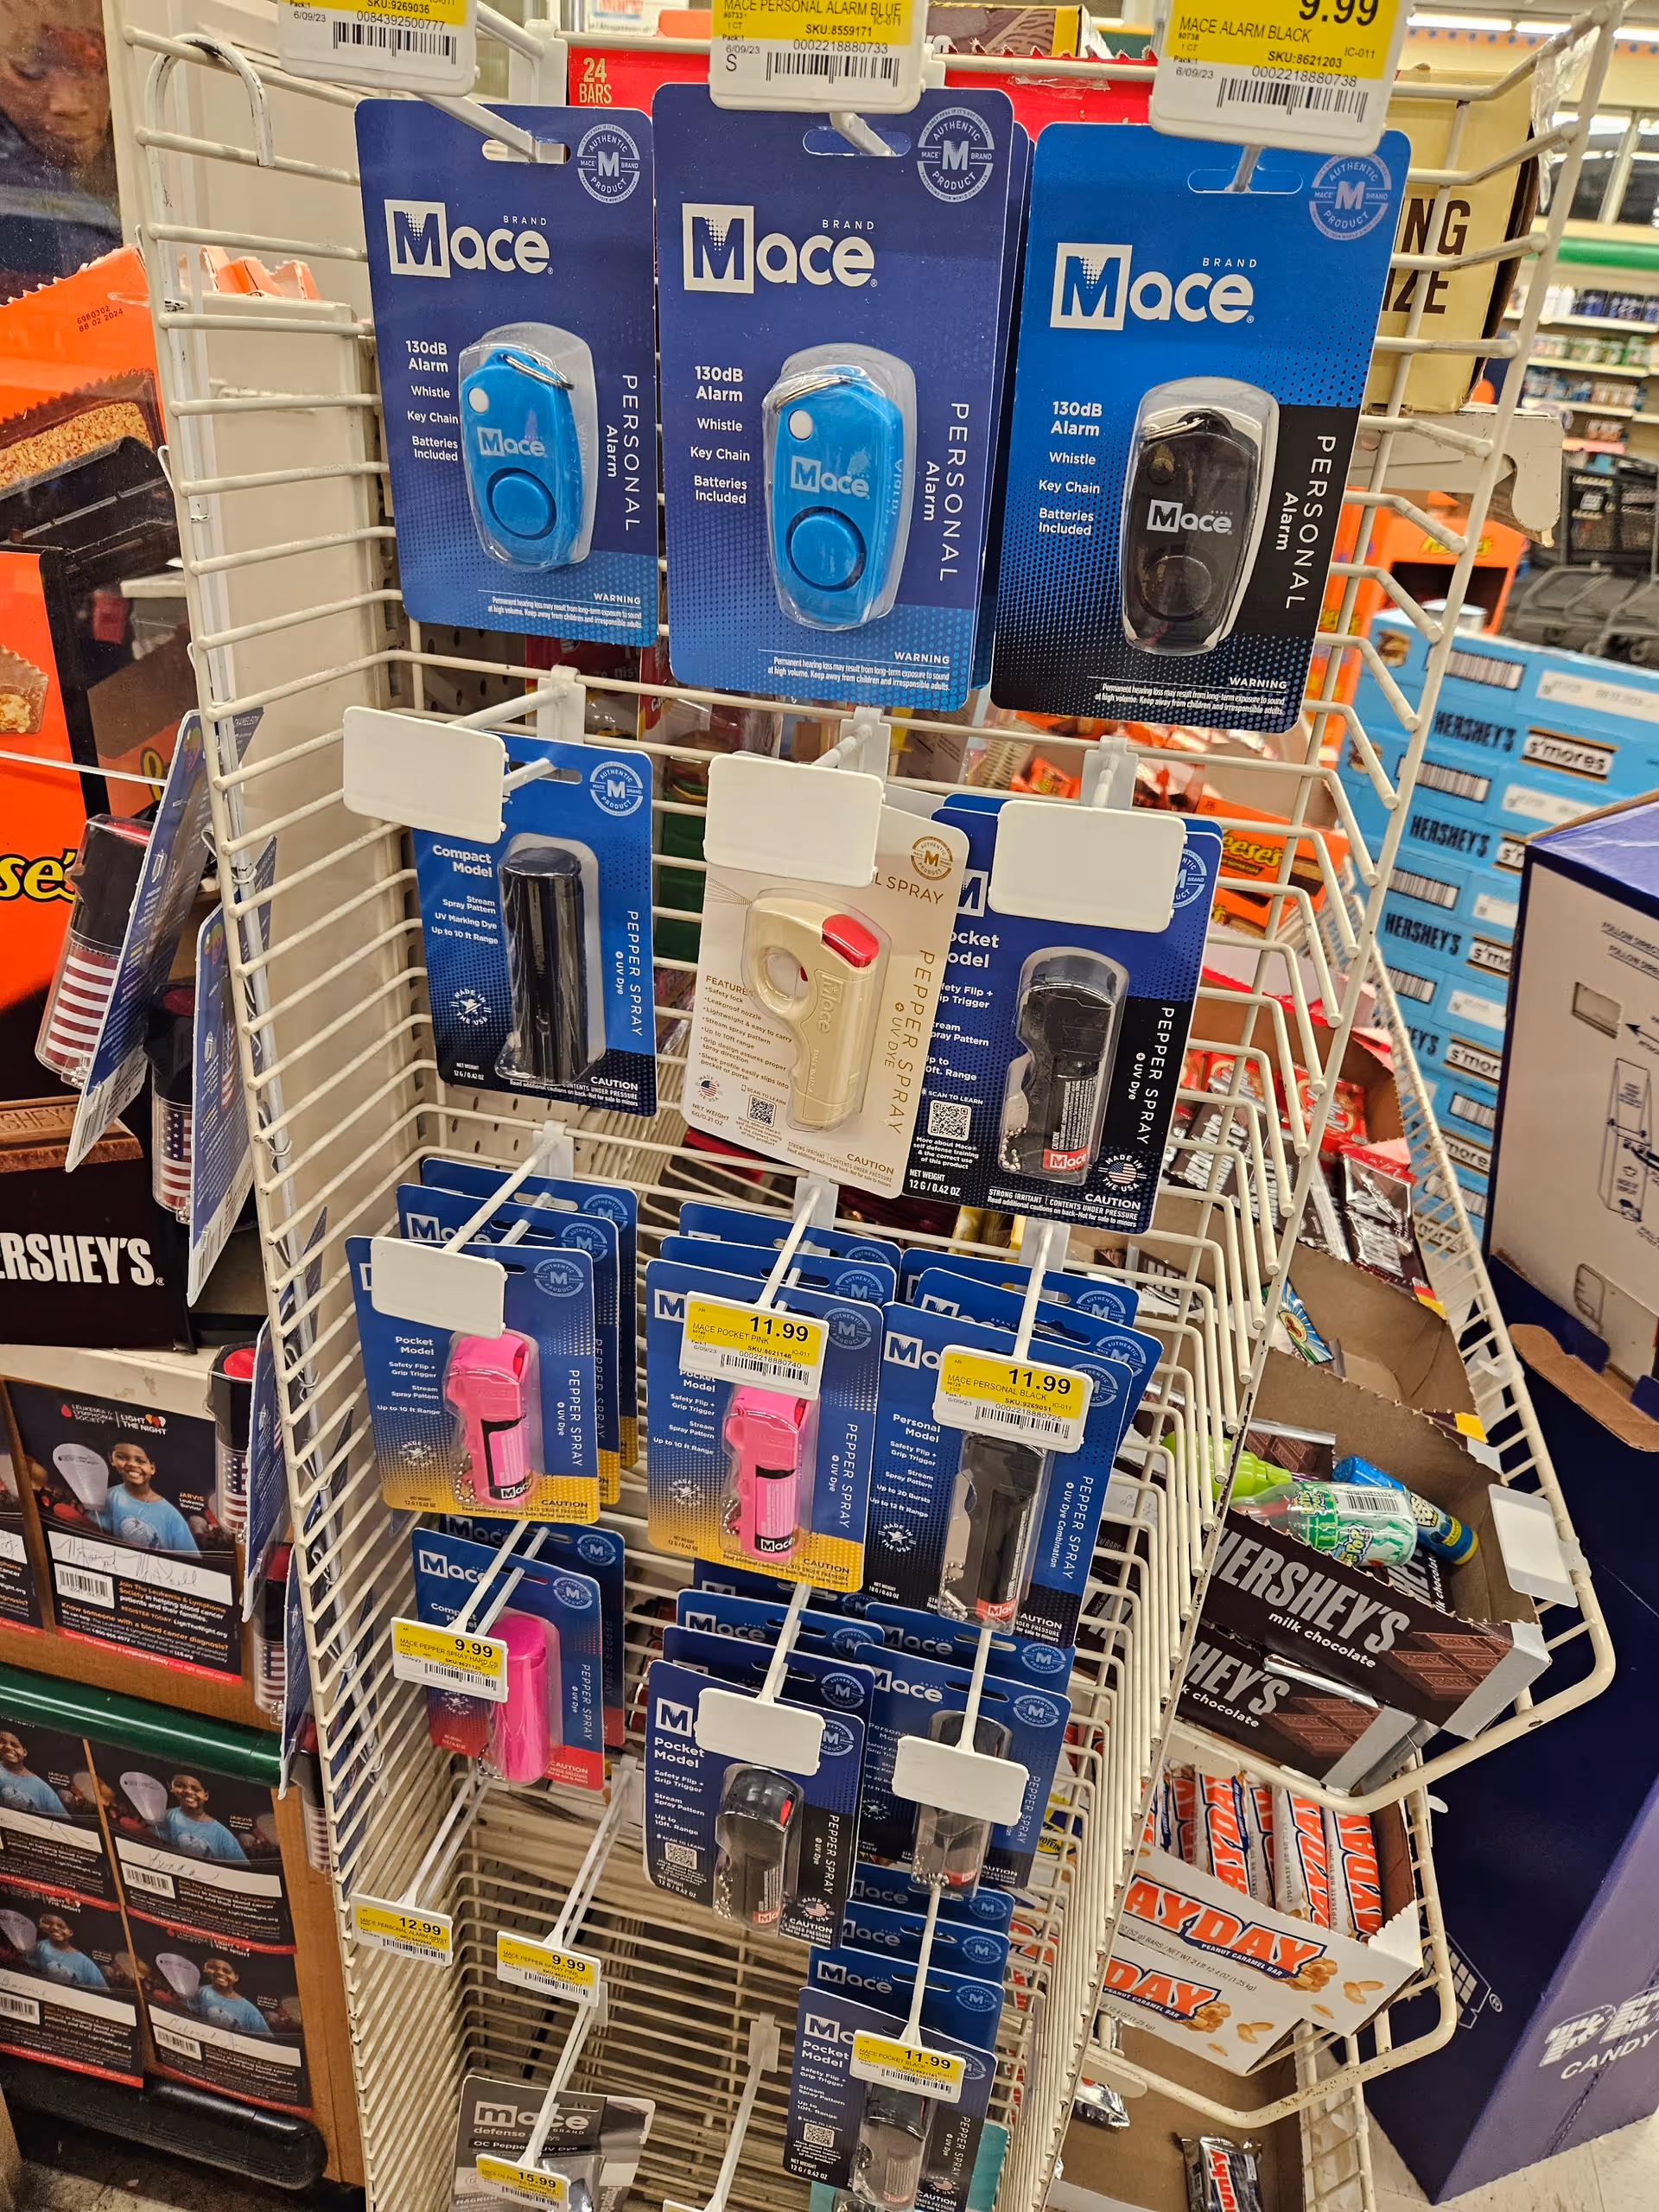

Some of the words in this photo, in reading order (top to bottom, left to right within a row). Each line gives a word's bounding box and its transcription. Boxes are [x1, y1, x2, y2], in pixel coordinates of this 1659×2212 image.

[294, 11, 326, 22] 6/09/23
[367, 0, 429, 14] SKU:9269036
[724, 0, 757, 10] MACE
[760, 0, 822, 13] PERSONAL
[826, 2, 867, 15] ALARM
[871, 3, 901, 16] BLUE
[1300, 0, 1379, 26] 9.99
[357, 10, 445, 32] 0084392500777
[806, 24, 872, 36] SKU:8559171
[1180, 16, 1217, 34] MACE
[1220, 21, 1265, 38] ALARM
[1268, 25, 1313, 43] BLACK
[793, 39, 888, 54] 0002218880733
[1344, 47, 1376, 59] IC-011
[1268, 51, 1342, 67] SKU:8621203
[583, 57, 607, 83] 24
[1252, 65, 1357, 87] 0002218880738
[579, 83, 612, 104] BARS
[933, 121, 981, 142] AUTHENTIC
[931, 169, 976, 191] PRODUCT
[823, 219, 875, 230] BRAND
[385, 199, 550, 278] Mace
[682, 202, 875, 294] Mace
[1050, 242, 1254, 330] Mace
[76, 305, 111, 325] 6980302
[79, 322, 90, 333] BB
[92, 318, 102, 327] 02
[104, 308, 124, 322] 2024
[695, 365, 743, 383] 130dB
[696, 385, 743, 402] Alarm
[1052, 401, 1103, 419] 130dB
[696, 418, 743, 432] Whistle
[1051, 420, 1100, 436] Alarm
[477, 427, 546, 458] Mace
[622, 374, 641, 531] PERSONAL
[690, 447, 713, 461] Key
[716, 448, 750, 461] Chain
[1049, 451, 1096, 465] Whistle
[694, 475, 747, 491] Batteries
[923, 461, 940, 522] Alarm
[939, 403, 969, 582] PERSONAL
[1039, 480, 1061, 493] Key
[1065, 481, 1101, 494] Chain
[696, 489, 747, 505] Included
[1039, 508, 1094, 523] Batteries
[1274, 492, 1300, 551] Alarm
[1285, 435, 1337, 609] PERSONAL
[1039, 522, 1092, 536] Included
[894, 652, 950, 664] WARNING
[774, 657, 803, 667] Permanent
[803, 660, 822, 670] hearing
[823, 661, 832, 671] loss
[833, 663, 845, 672] may
[845, 664, 861, 672] result
[861, 665, 874, 674] from
[874, 666, 900, 677] long-term
[901, 671, 926, 681] exposure
[1230, 677, 1287, 690] WARNING
[432, 844, 492, 864] Compact
[453, 861, 493, 878] Model
[887, 876, 944, 905] SPRAY
[1384, 912, 1462, 957] HERSHEY'S
[708, 987, 729, 998] Safety
[730, 995, 744, 1004] lock
[904, 950, 935, 1048] PEPPER
[707, 997, 740, 1014] Leakproof
[741, 1009, 762, 1021] nozzle
[705, 1017, 728, 1030] Stream
[729, 1024, 746, 1036] spray
[747, 1033, 771, 1046] pattern
[1154, 1006, 1175, 1080] PEPPER
[590, 1076, 639, 1091] CAUTION
[889, 1062, 913, 1135] SPRAY
[960, 1096, 983, 1105] LEARN
[1135, 1087, 1160, 1146] SPRAY
[847, 1153, 894, 1175] CAUTION
[988, 1189, 1013, 1199] STRONG
[1014, 1193, 1042, 1204] IRRITANT
[1050, 1199, 1081, 1210] CONTENTS
[1083, 1205, 1103, 1214] UNDER
[1105, 1210, 1138, 1220] PRESSURE
[1084, 1193, 1141, 1211] CAUTION
[693, 1323, 715, 1334] MACE
[717, 1327, 749, 1340] POCKET
[751, 1335, 769, 1344] PINK
[750, 1316, 809, 1342] 11.99
[395, 1336, 433, 1345] Pocket
[401, 1346, 434, 1355] Model
[739, 1351, 802, 1369] 0002218880740
[747, 1345, 791, 1358] SKU:8621146
[683, 1379, 715, 1393] Model
[948, 1374, 972, 1385] MACE
[973, 1380, 1018, 1395] PERSONAL
[1020, 1390, 1047, 1401] BLACK
[1009, 1369, 1071, 1395] 11.99
[569, 1370, 581, 1425] PEPPER
[1005, 1398, 1052, 1412] SKU:9269051
[121, 1414, 146, 1424] LIGHT
[995, 1403, 1062, 1422] 0002218880725
[141, 1425, 167, 1435] NIGHT
[893, 1414, 940, 1433] Personal
[570, 1424, 584, 1466] SPRAY
[906, 1427, 939, 1443] Model
[845, 1423, 858, 1479] PEPPER
[179, 1492, 205, 1502] JARVIS
[840, 1478, 854, 1529] SPRAY
[803, 1558, 850, 1574] CAUTION
[1208, 1527, 1410, 1654] HERSHEY'S
[61, 1602, 82, 1613] Know
[83, 1608, 115, 1622] someone
[117, 1618, 133, 1626] with
[141, 1624, 162, 1634] blood
[162, 1630, 188, 1641] cancer
[189, 1636, 229, 1651] diagnosis?
[454, 1638, 493, 1658] 9.99
[1268, 1611, 1302, 1635] milk
[1304, 1628, 1377, 1669] chocolate
[400, 1638, 418, 1648] MACE
[419, 1643, 445, 1655] PEPPER
[447, 1650, 468, 1659] SPRAY
[470, 1656, 487, 1666] HARD
[1192, 1690, 1261, 1729] chocolate
[654, 1736, 705, 1758] Pocket
[654, 1749, 699, 1769] Model
[399, 1917, 441, 1936] 12.99
[1123, 1879, 1319, 1976] AYDAY
[552, 1955, 585, 1972] 9.99
[1201, 1943, 1230, 1956] PEANUT
[1231, 1953, 1265, 1970] CARAMEL
[1267, 1966, 1282, 1977] BAR
[817, 1960, 893, 1994] Mace
[801, 2050, 842, 2068] Model
[803, 2040, 849, 2060] Pocket
[905, 2050, 950, 2069] 11.99
[1560, 2030, 1658, 2079] CANDY
[474, 2127, 526, 2137] defense
[518, 2171, 556, 2188] 15.99
